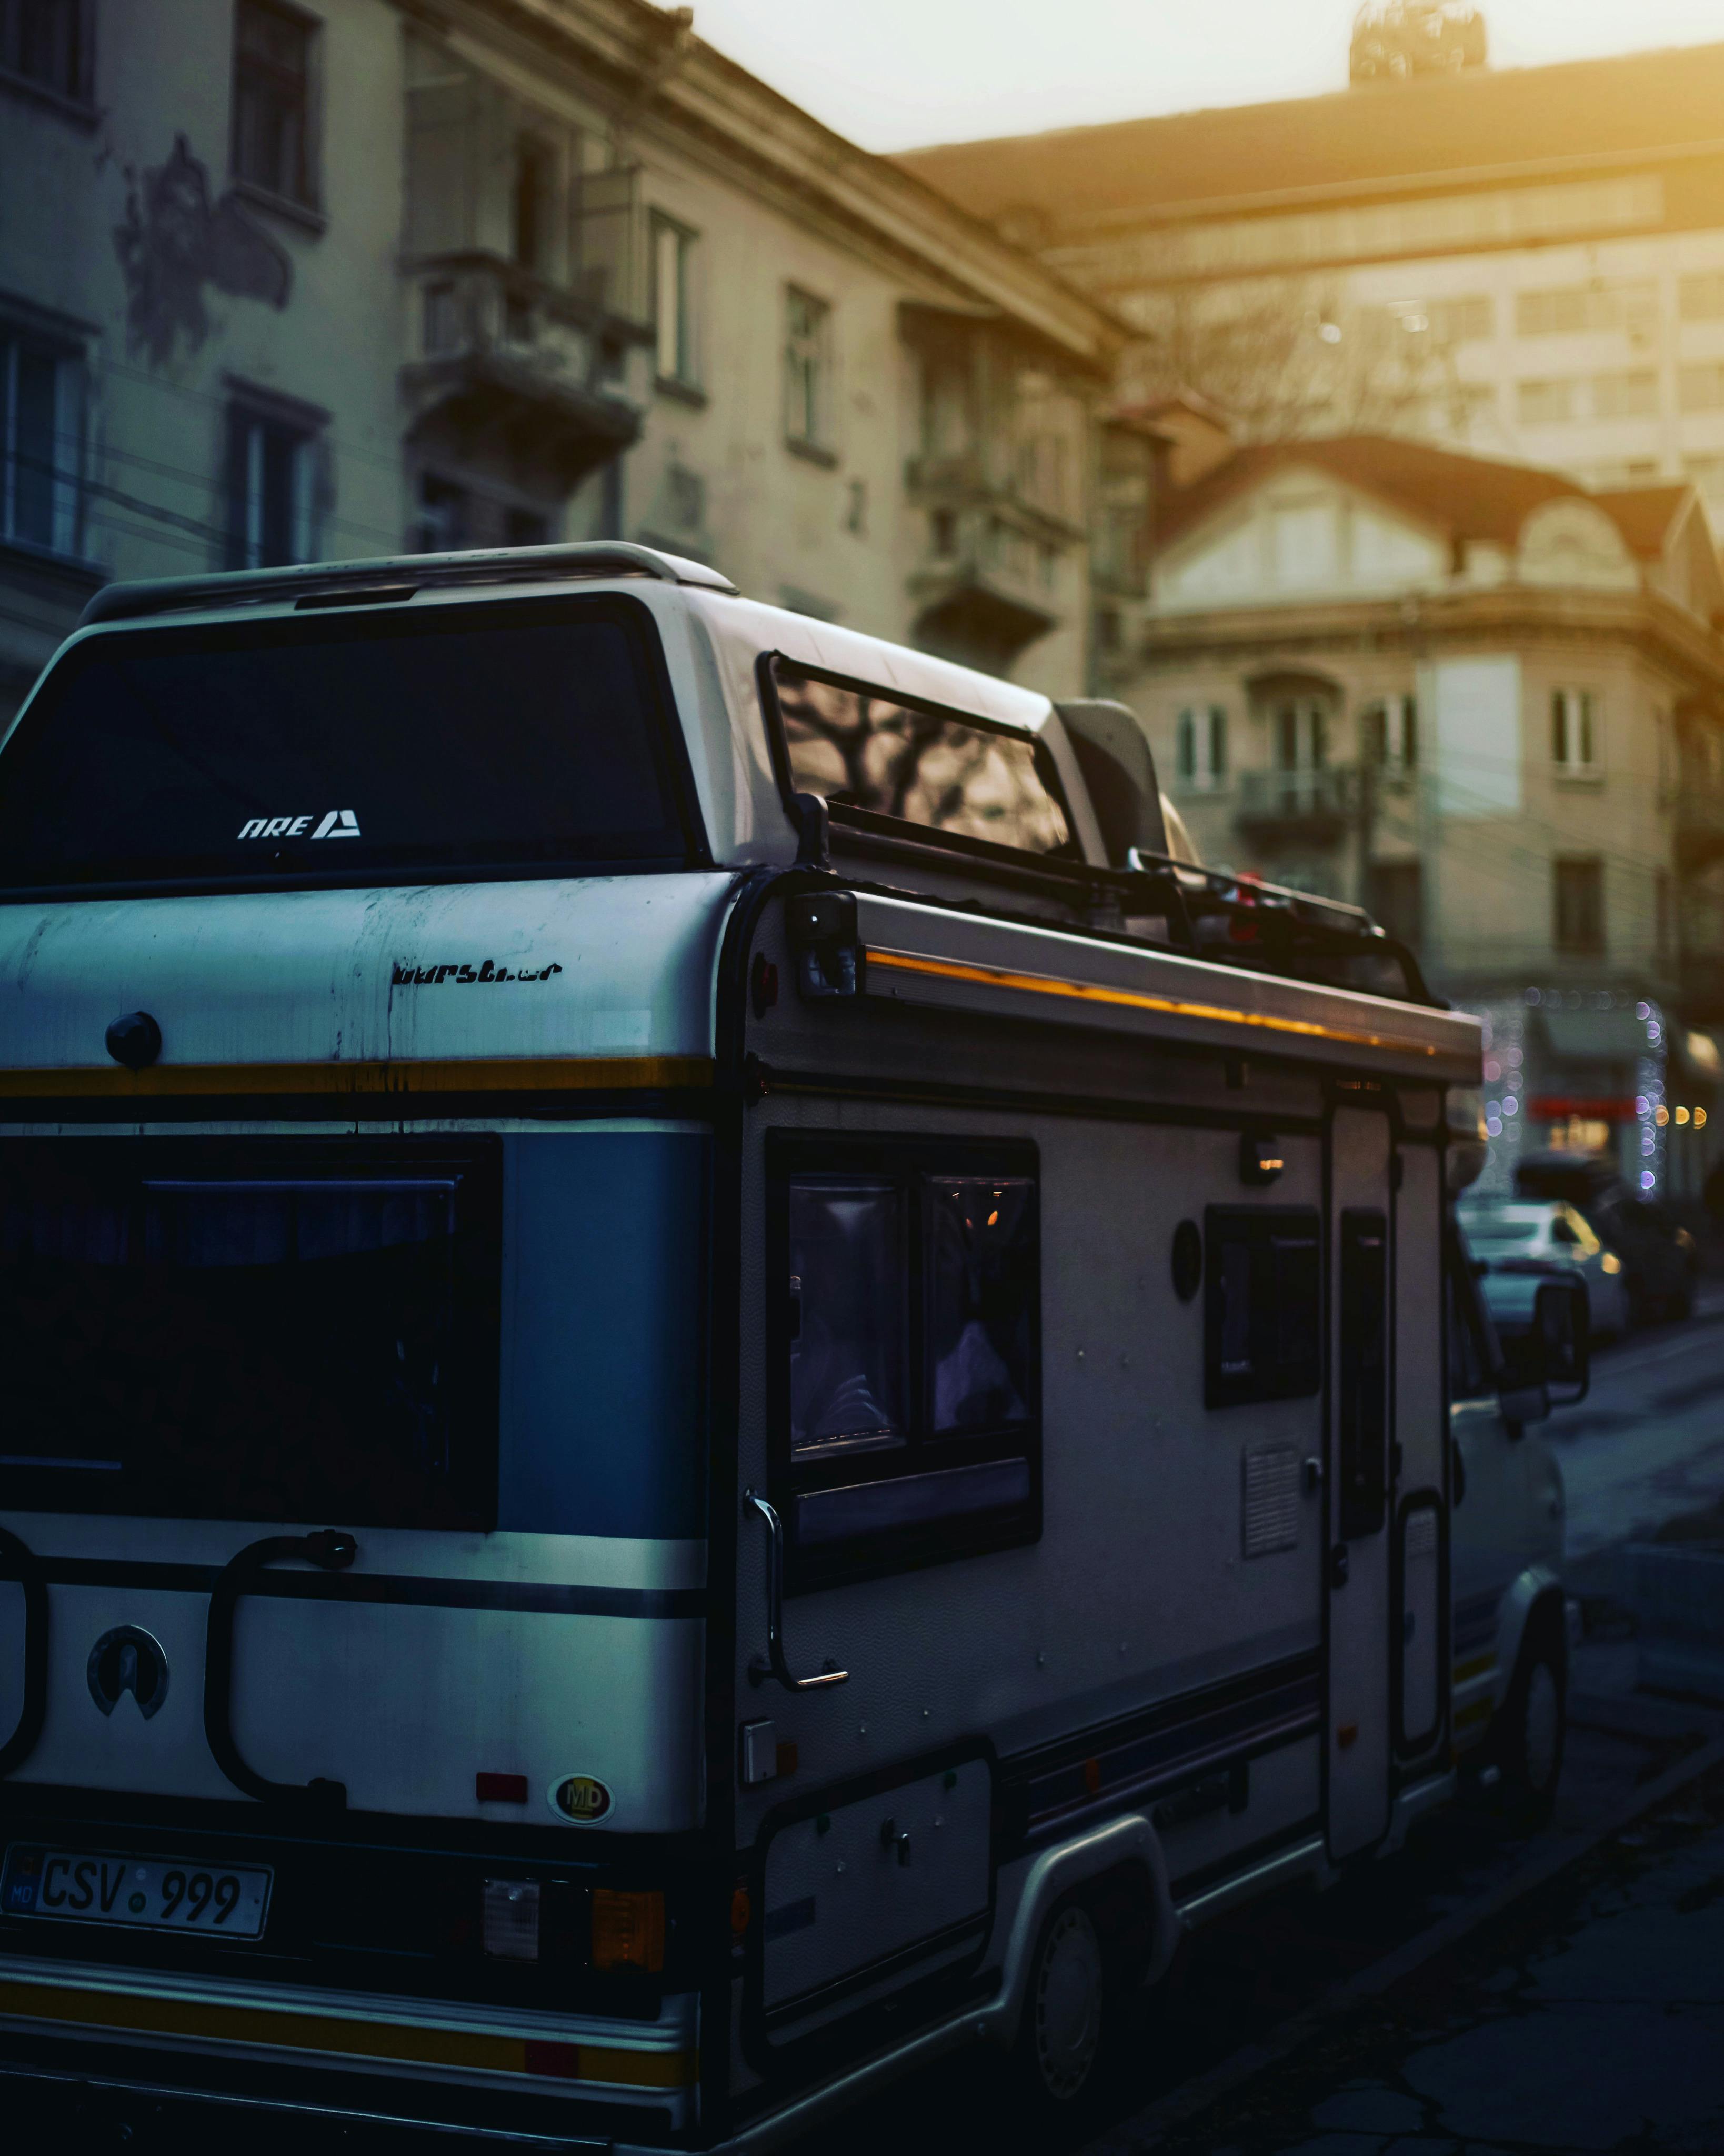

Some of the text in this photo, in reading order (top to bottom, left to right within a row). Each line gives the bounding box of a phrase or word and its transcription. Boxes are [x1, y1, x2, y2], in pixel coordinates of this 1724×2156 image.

[237, 815, 313, 839] ARE
[566, 1783, 603, 1808] MD
[10, 1885, 33, 1904] MD
[42, 1859, 242, 1924] CSV 999
